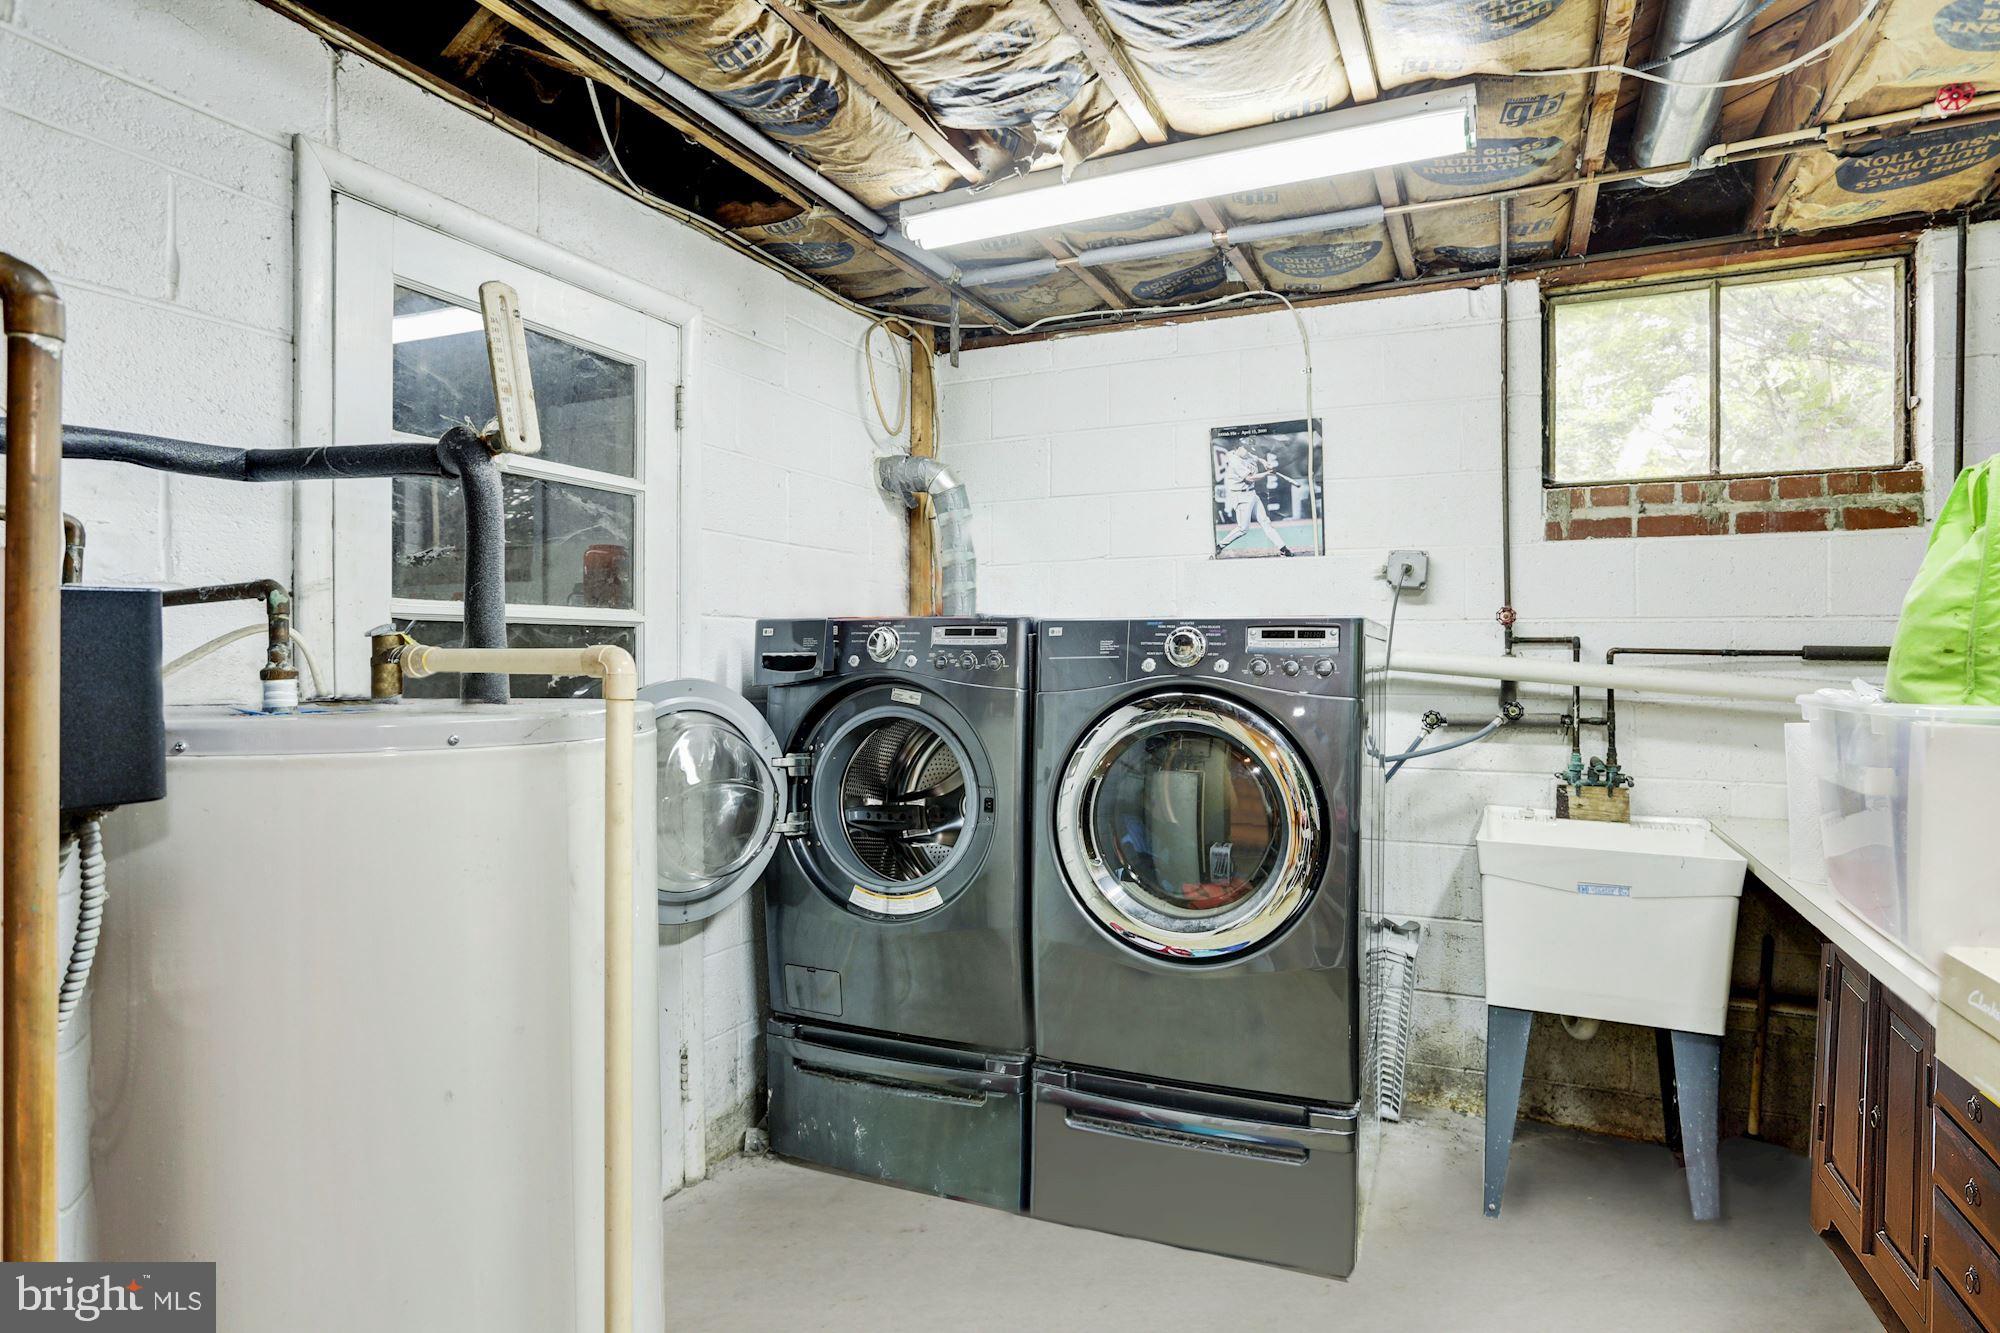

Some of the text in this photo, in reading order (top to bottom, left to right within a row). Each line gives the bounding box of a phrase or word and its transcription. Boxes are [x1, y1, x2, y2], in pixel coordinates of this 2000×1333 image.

[1483, 141, 1542, 157] GLASS
[1854, 134, 2000, 168] NSULATION
[1867, 144, 1992, 178] BUILDING
[1855, 154, 1987, 190] FIBER GLASS
